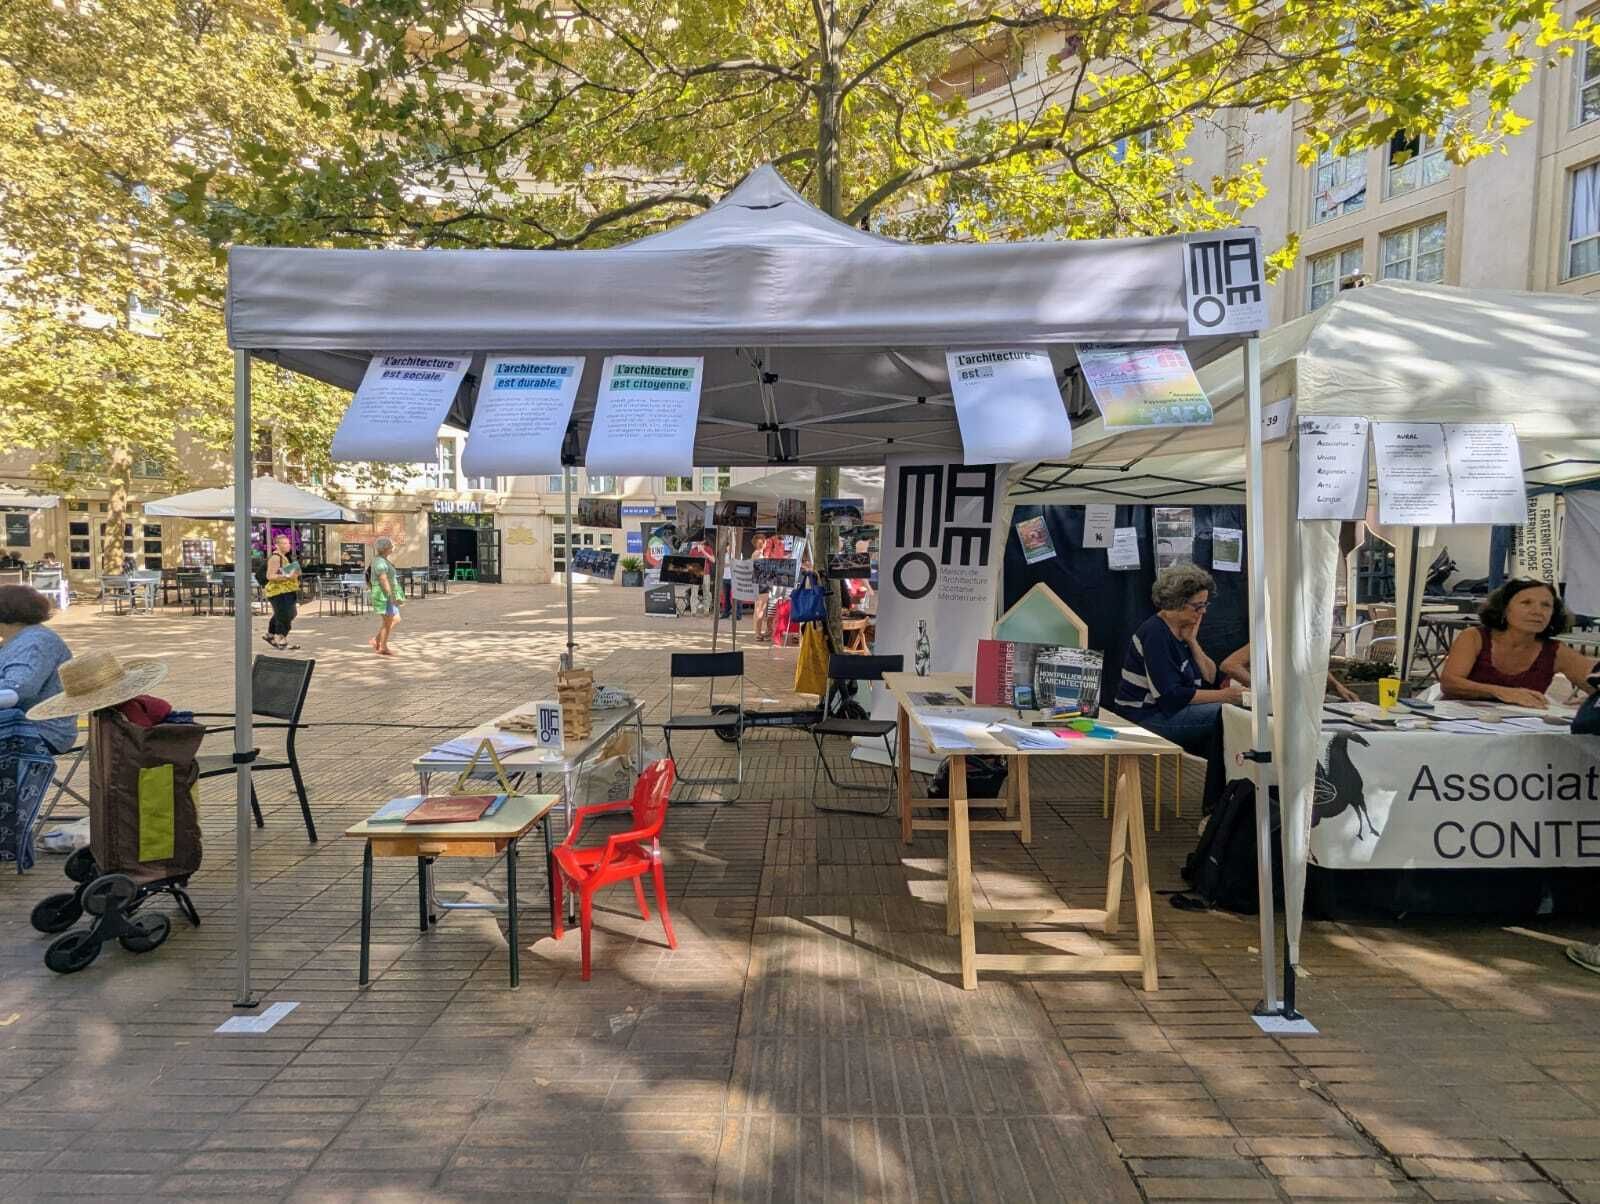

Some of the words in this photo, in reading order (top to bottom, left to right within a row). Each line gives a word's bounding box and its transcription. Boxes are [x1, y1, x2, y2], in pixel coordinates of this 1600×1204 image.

[384, 355, 455, 369] L'architecture
[957, 350, 1032, 366] L'architecture
[382, 370, 400, 379] est
[497, 363, 568, 375] L'architecture
[617, 364, 689, 377] L'architecture
[961, 367, 981, 379] est
[497, 378, 516, 388] est
[612, 378, 633, 389] est
[633, 379, 690, 391] citoyenne.
[1407, 763, 1600, 802] Associat
[1433, 820, 1600, 860] CONTE
